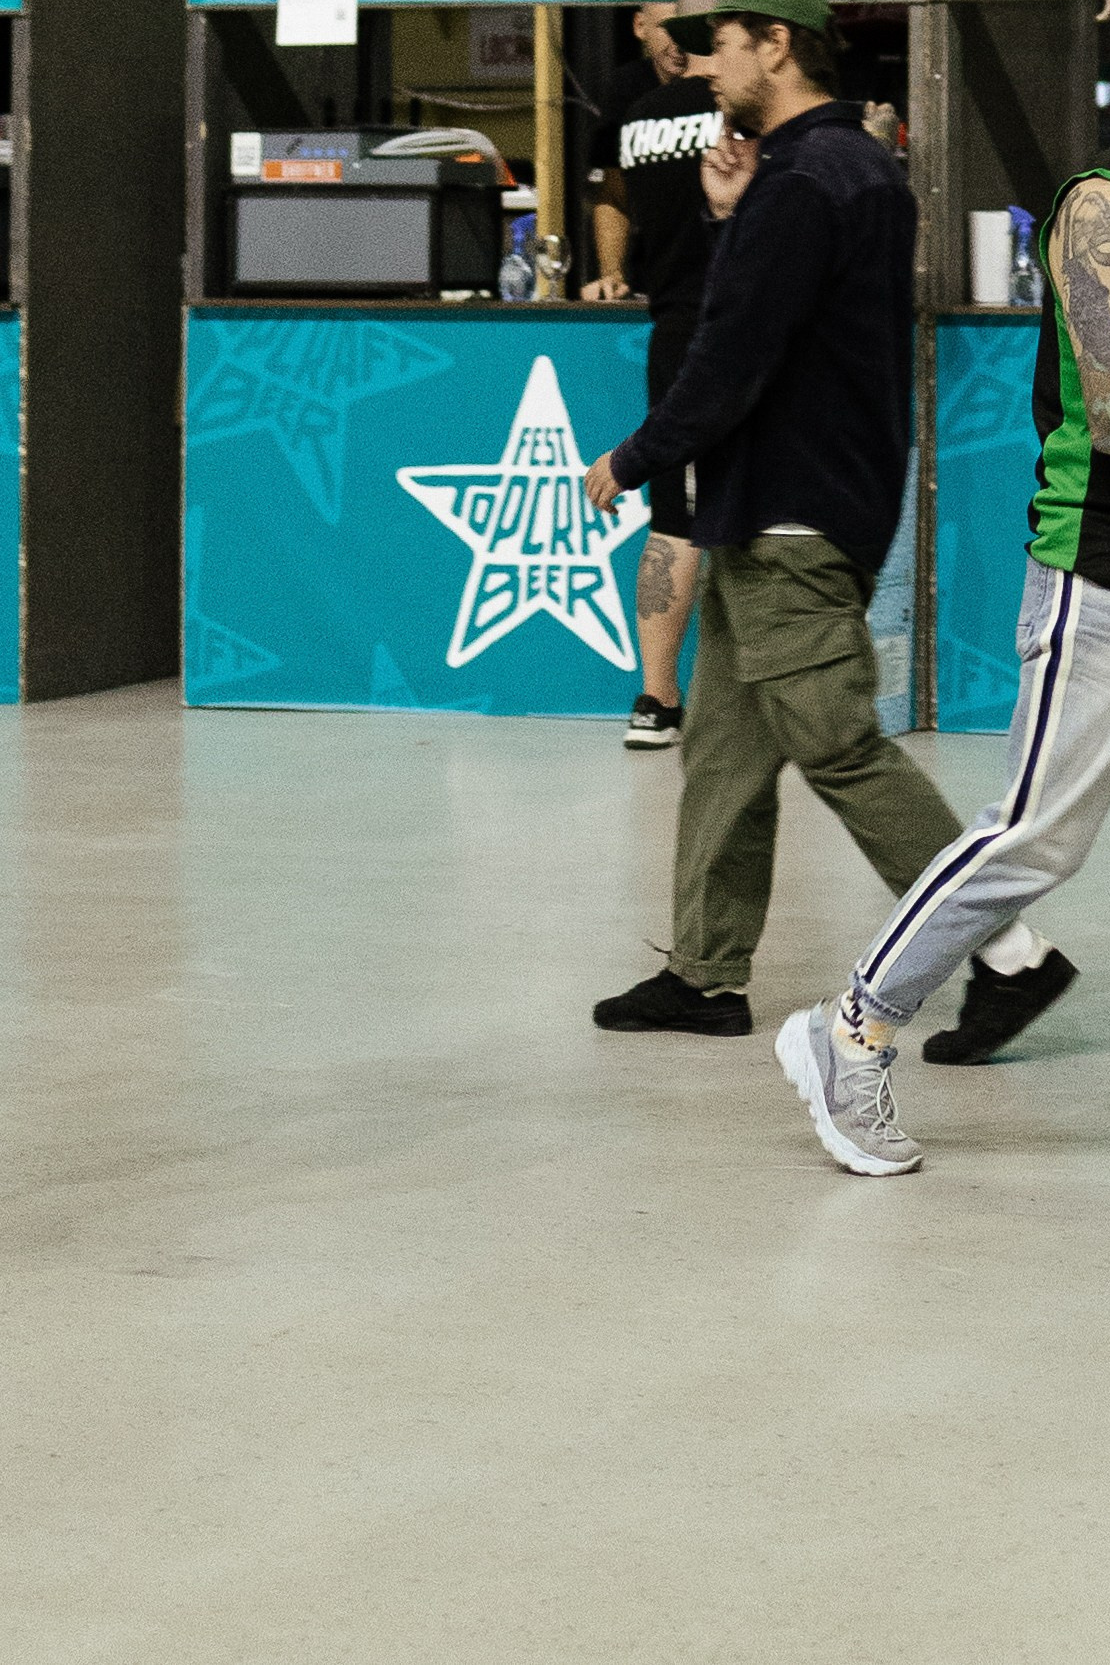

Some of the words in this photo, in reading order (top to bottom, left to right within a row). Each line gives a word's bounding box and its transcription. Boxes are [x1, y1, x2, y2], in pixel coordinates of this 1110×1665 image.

[513, 426, 568, 467] FEST
[409, 473, 650, 557] TOPCRA
[459, 563, 626, 658] BEER
